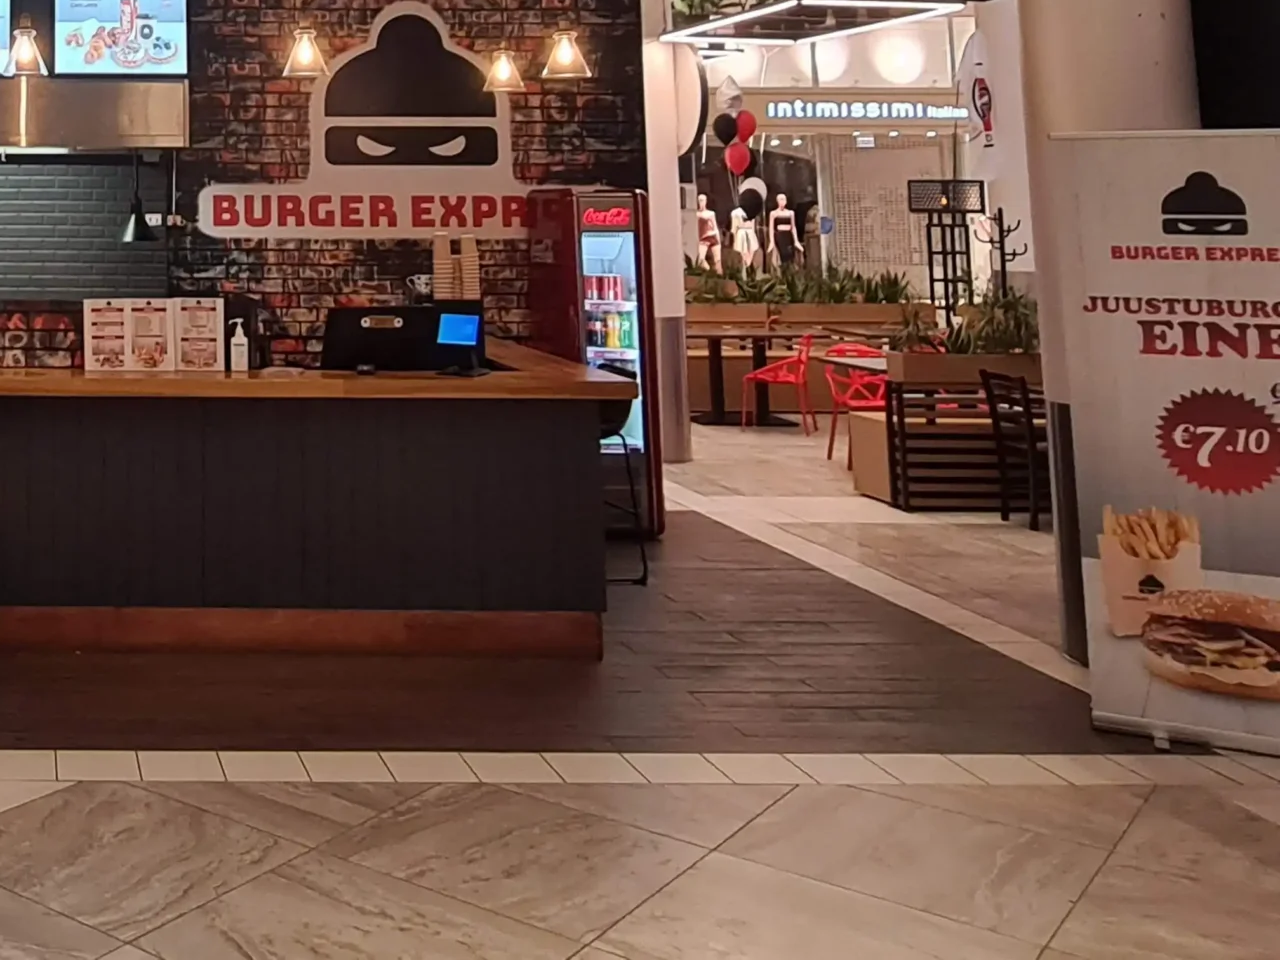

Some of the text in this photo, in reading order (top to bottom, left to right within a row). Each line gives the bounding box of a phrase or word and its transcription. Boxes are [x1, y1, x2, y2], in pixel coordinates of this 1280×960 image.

[766, 99, 923, 119] intimissimi
[211, 194, 398, 228] BURGER
[1110, 246, 1200, 261] BURGER
[1136, 320, 1280, 359] EINE
[1173, 423, 1270, 468] €7.10
